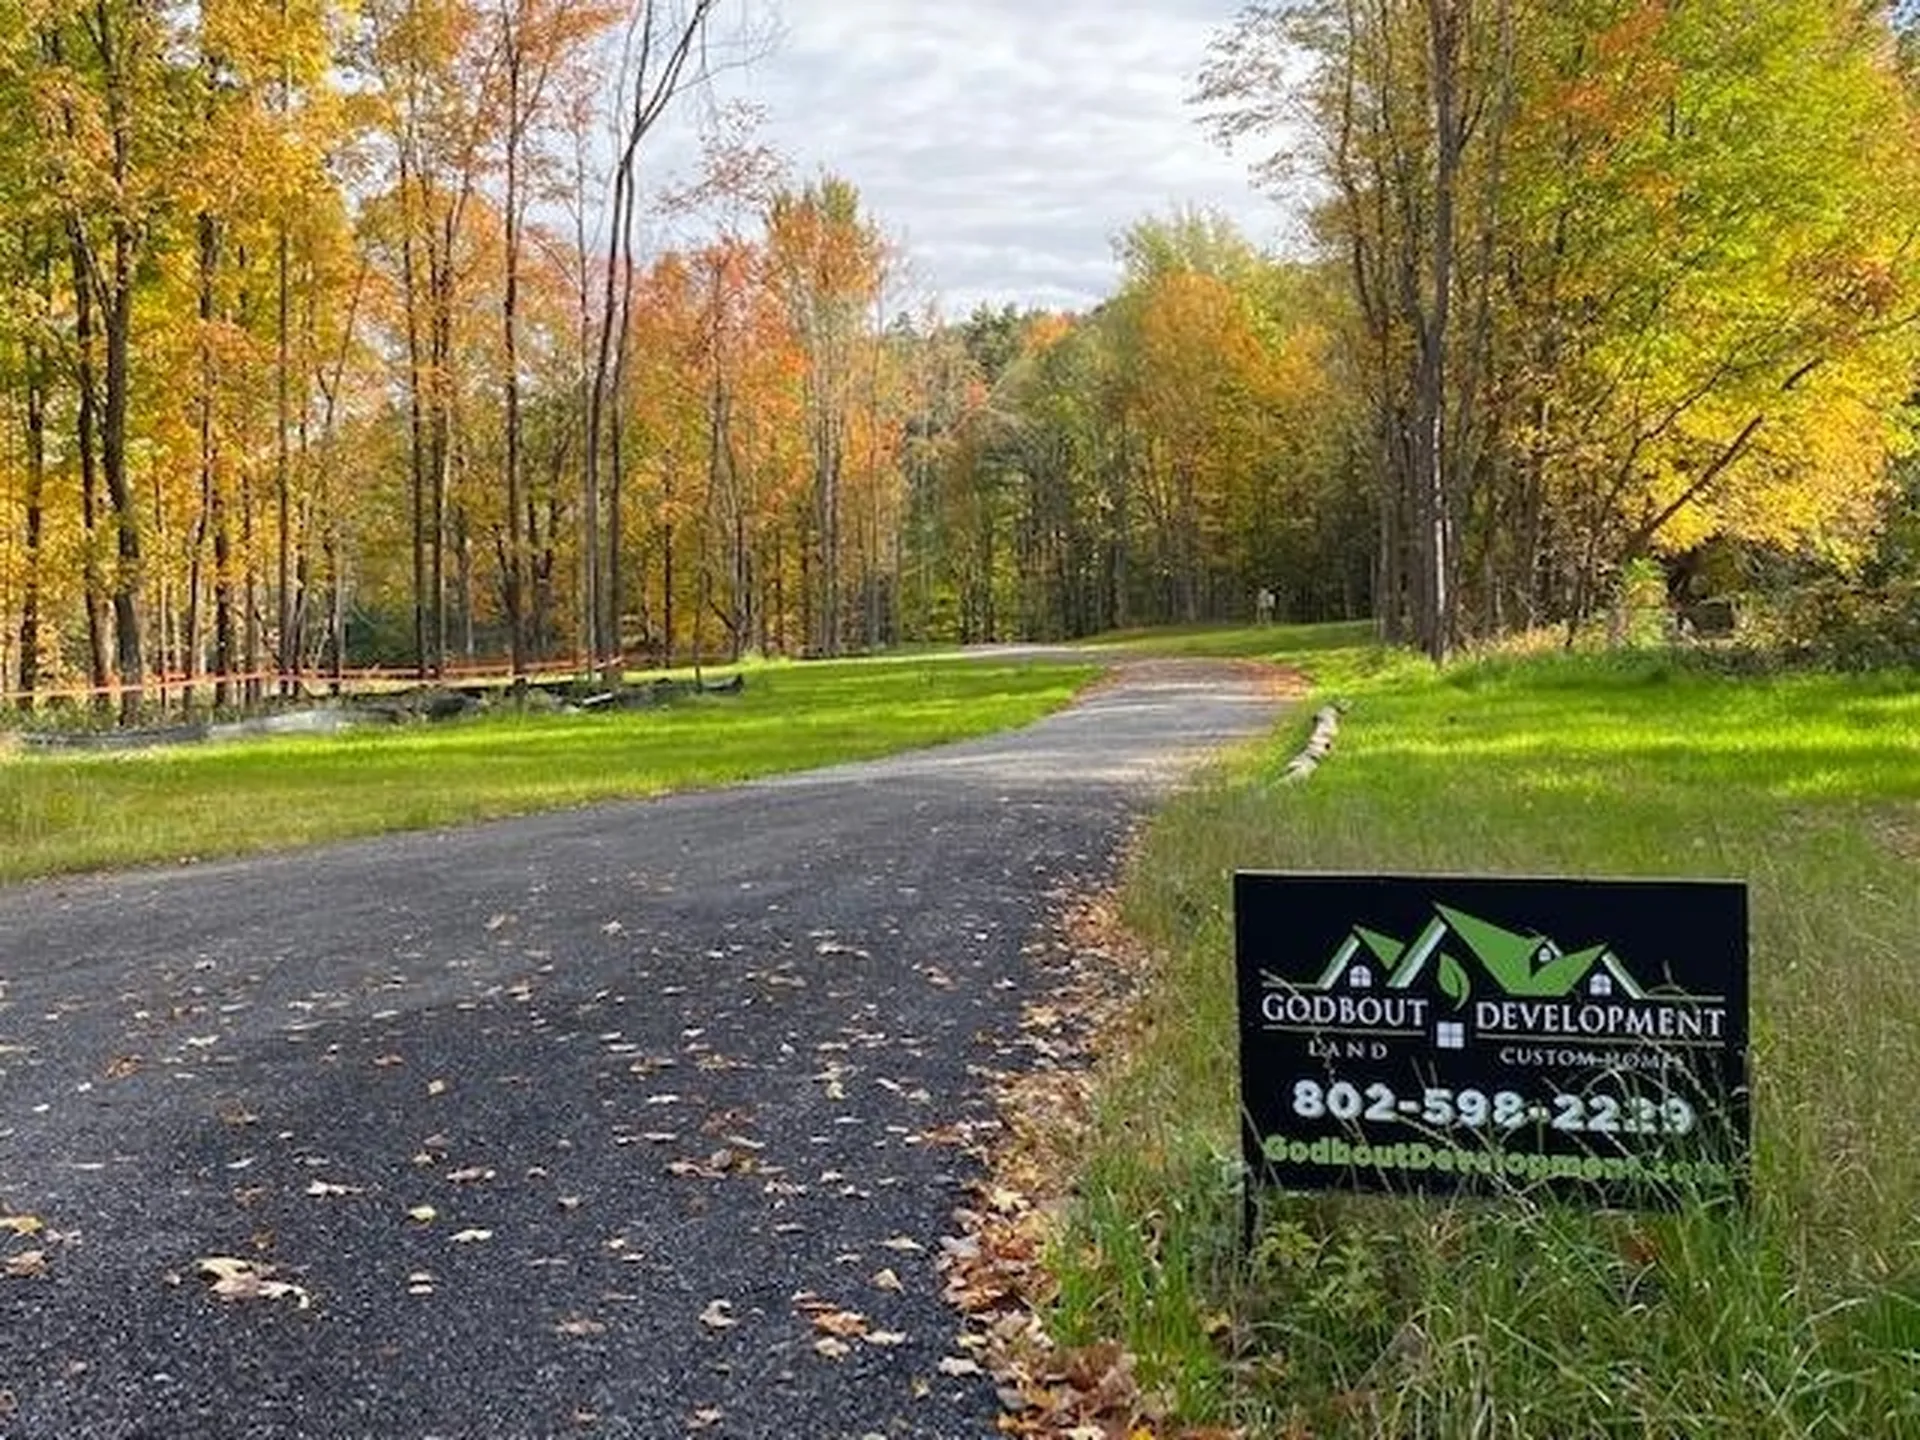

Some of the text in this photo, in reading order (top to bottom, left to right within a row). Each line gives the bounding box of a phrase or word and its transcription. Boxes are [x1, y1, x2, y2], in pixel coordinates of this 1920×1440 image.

[1262, 993, 1727, 1037] GODBOUT DEVELOPMENT
[1308, 1040, 1388, 1060] LAND
[1500, 1047, 1595, 1066] CUSTOM
